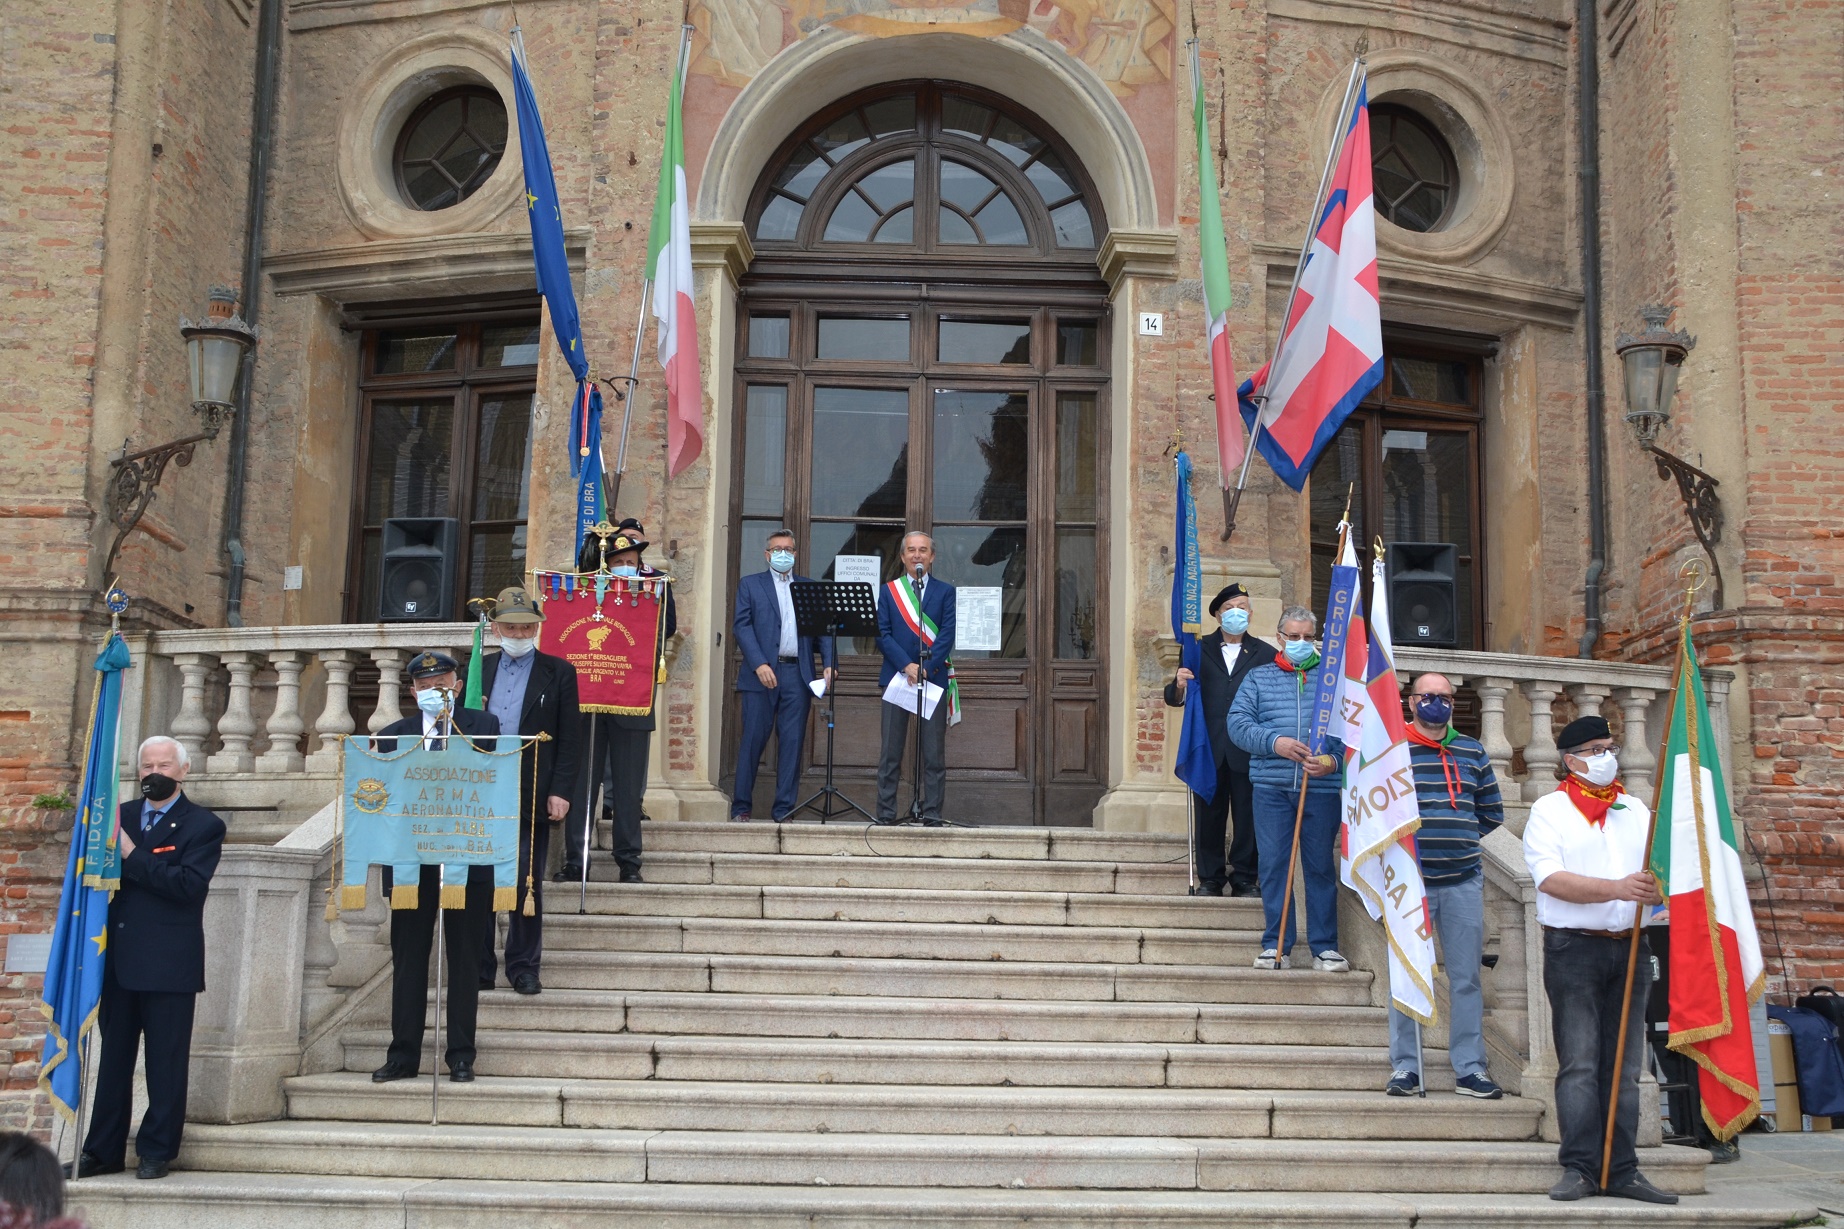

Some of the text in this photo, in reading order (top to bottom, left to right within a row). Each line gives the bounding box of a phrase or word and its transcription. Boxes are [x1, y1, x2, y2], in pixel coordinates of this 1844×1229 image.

[1145, 317, 1158, 331] 14
[584, 482, 594, 502] BRA
[583, 506, 594, 515] DI
[558, 617, 587, 643] ASSOCIAZIONE
[613, 620, 636, 646] BERSAGLIERI
[592, 654, 628, 662] BERSAGLIERE
[593, 661, 617, 669] SILVESTRO
[592, 668, 614, 676] ARGENTO
[1314, 590, 1348, 755] GRUPPO DI BRA
[403, 767, 497, 784] ASSOCIAZIONE
[418, 787, 480, 803] ARMA
[402, 804, 495, 818] AERONAUTICA
[454, 820, 485, 836] ALBA
[467, 839, 494, 853] BRA
